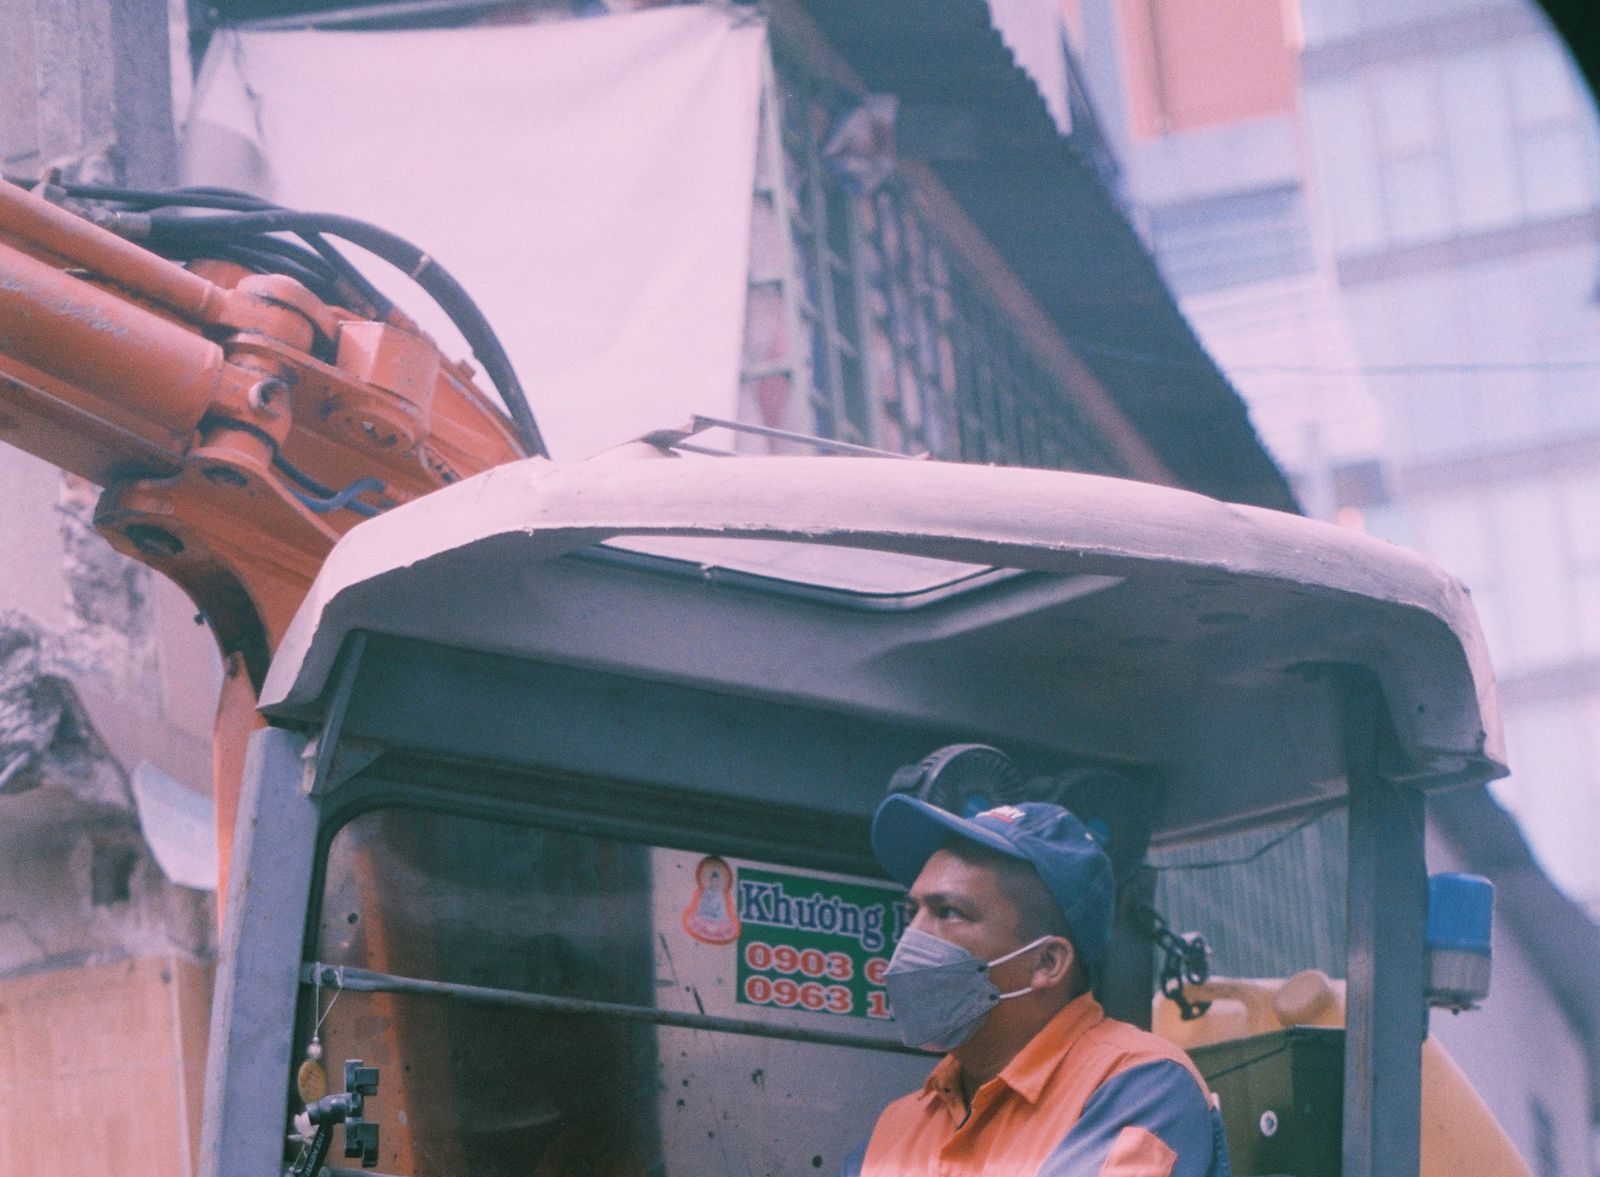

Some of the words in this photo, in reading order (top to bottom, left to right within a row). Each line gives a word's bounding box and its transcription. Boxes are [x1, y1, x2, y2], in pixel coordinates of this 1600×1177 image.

[740, 880, 885, 952] Khương
[745, 942, 853, 981] 0903
[864, 957, 888, 986] 6
[744, 975, 853, 1013] 0963
[867, 991, 892, 1019] 1
